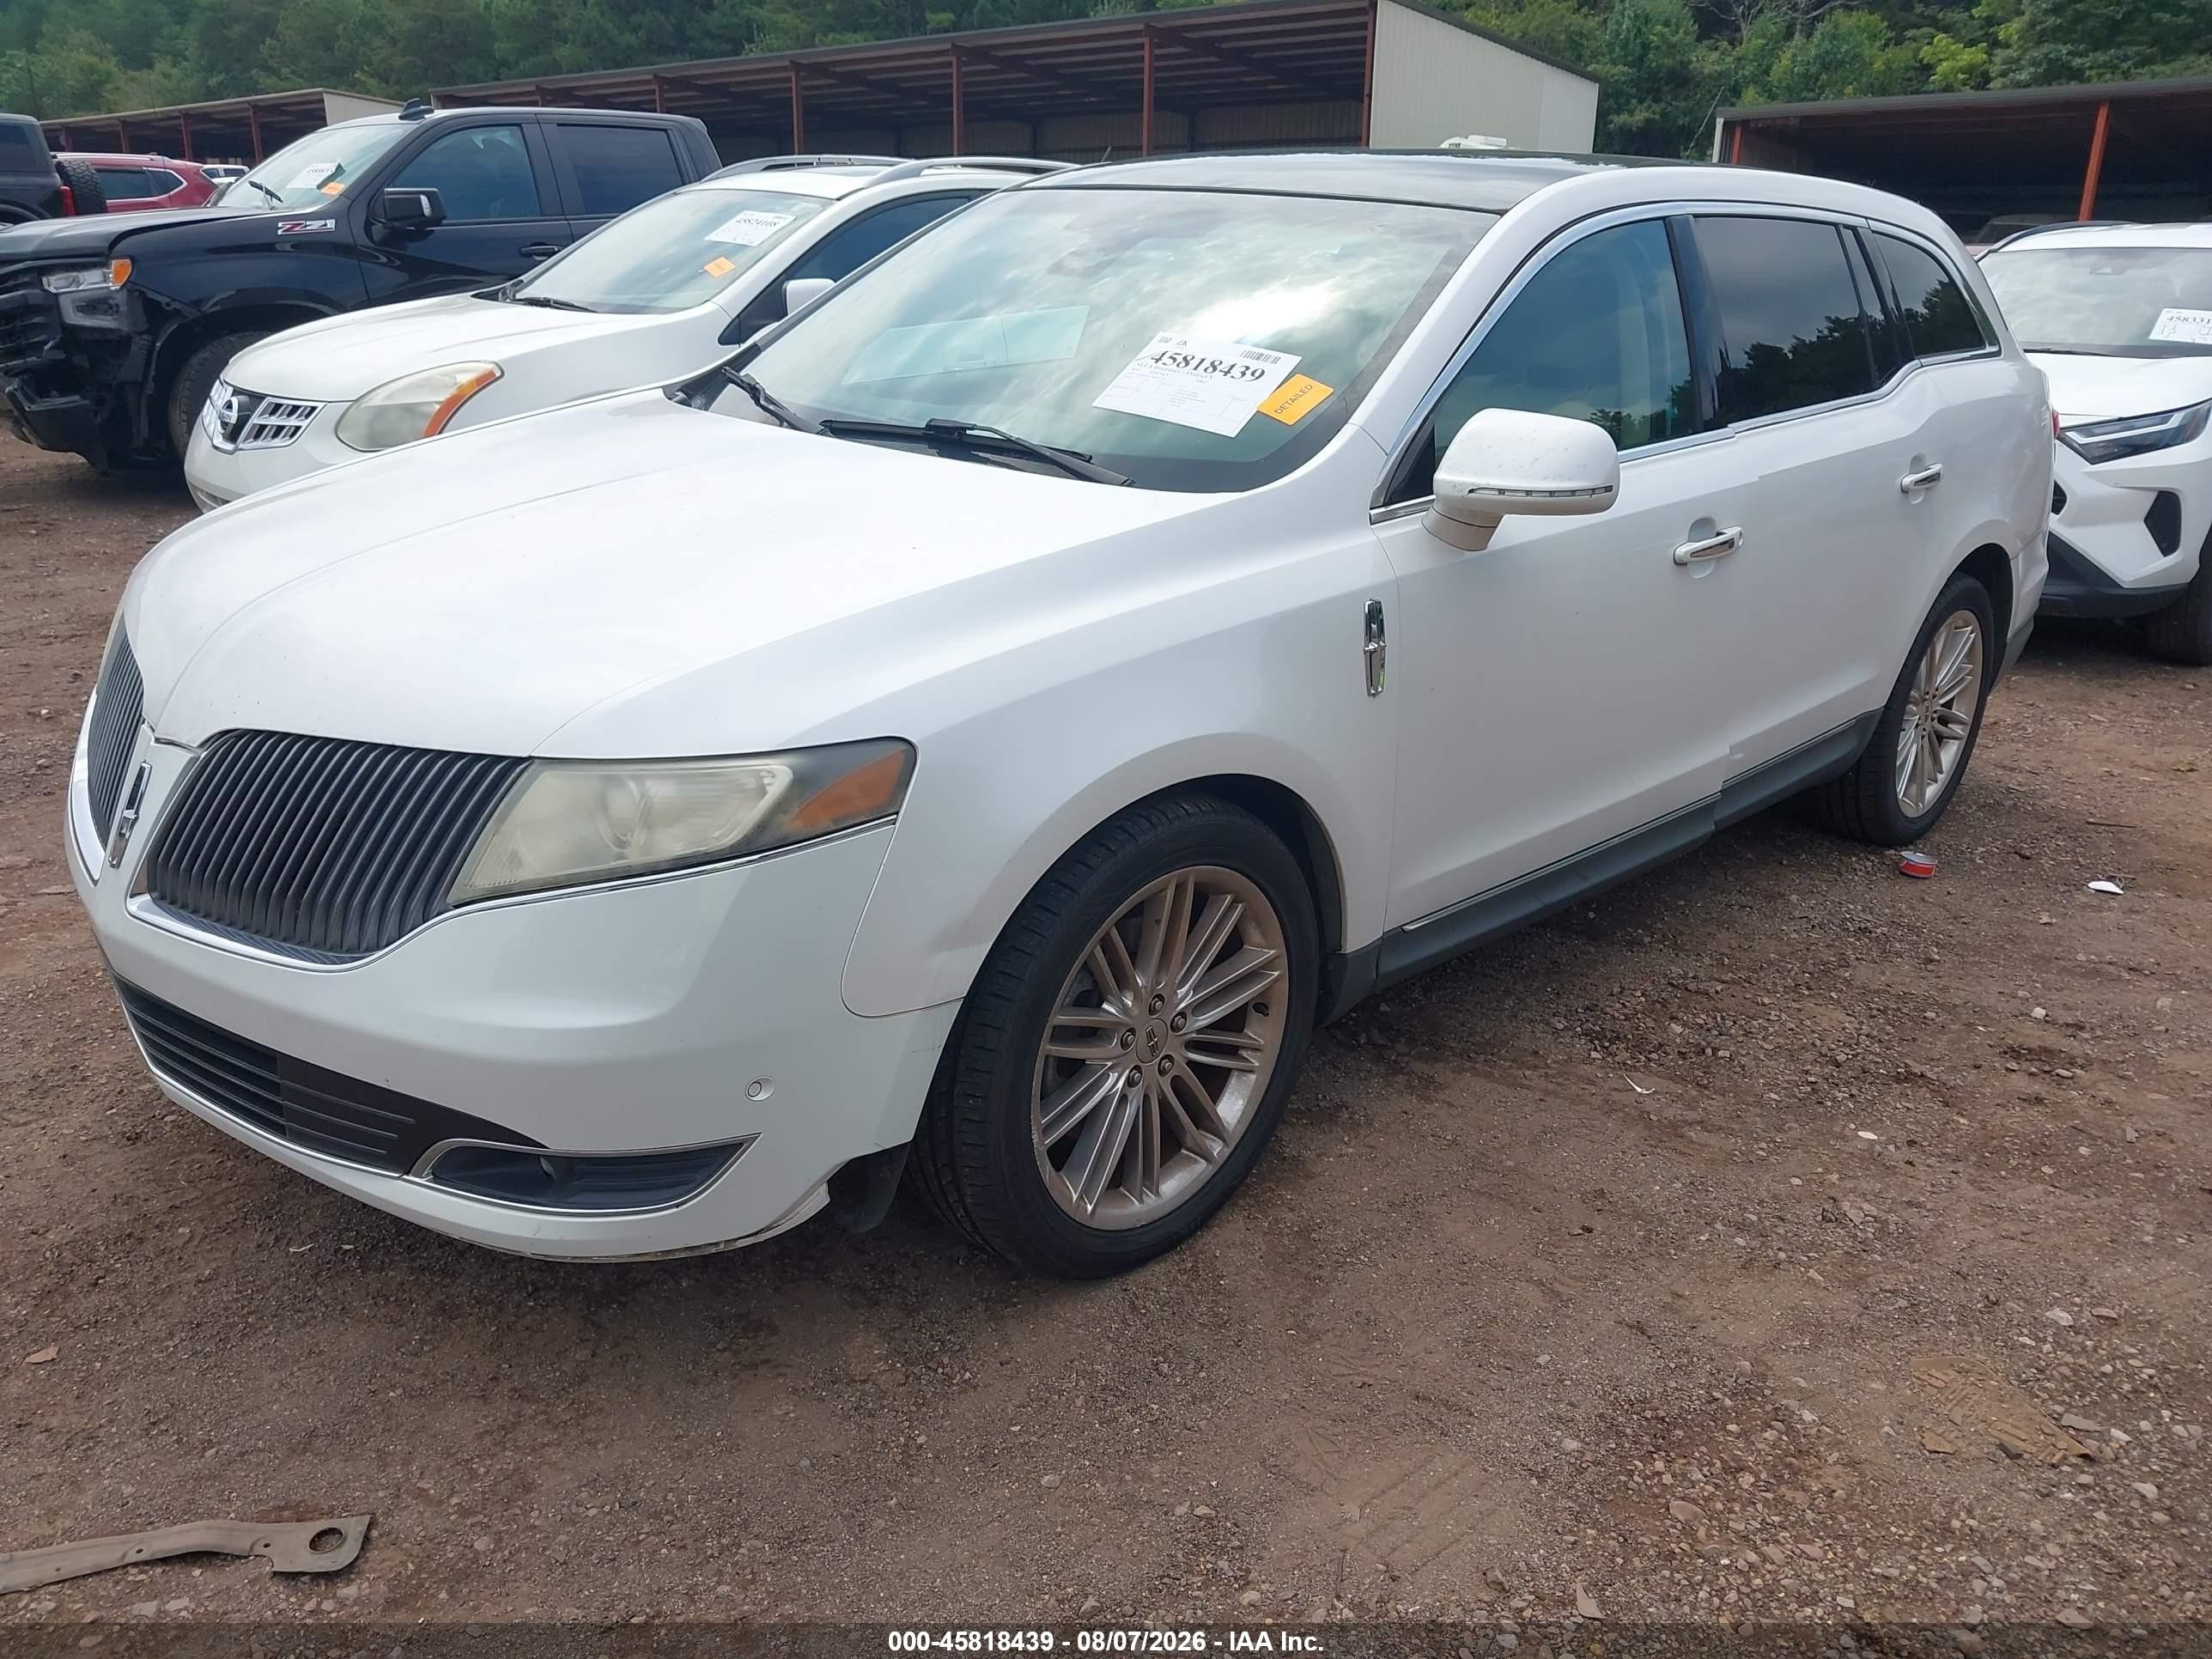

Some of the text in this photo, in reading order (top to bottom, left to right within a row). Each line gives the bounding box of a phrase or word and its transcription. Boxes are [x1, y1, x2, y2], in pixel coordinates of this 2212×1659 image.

[277, 219, 336, 235] Z71
[1151, 350, 1266, 381] 45818439
[1274, 384, 1313, 415] DETAILED
